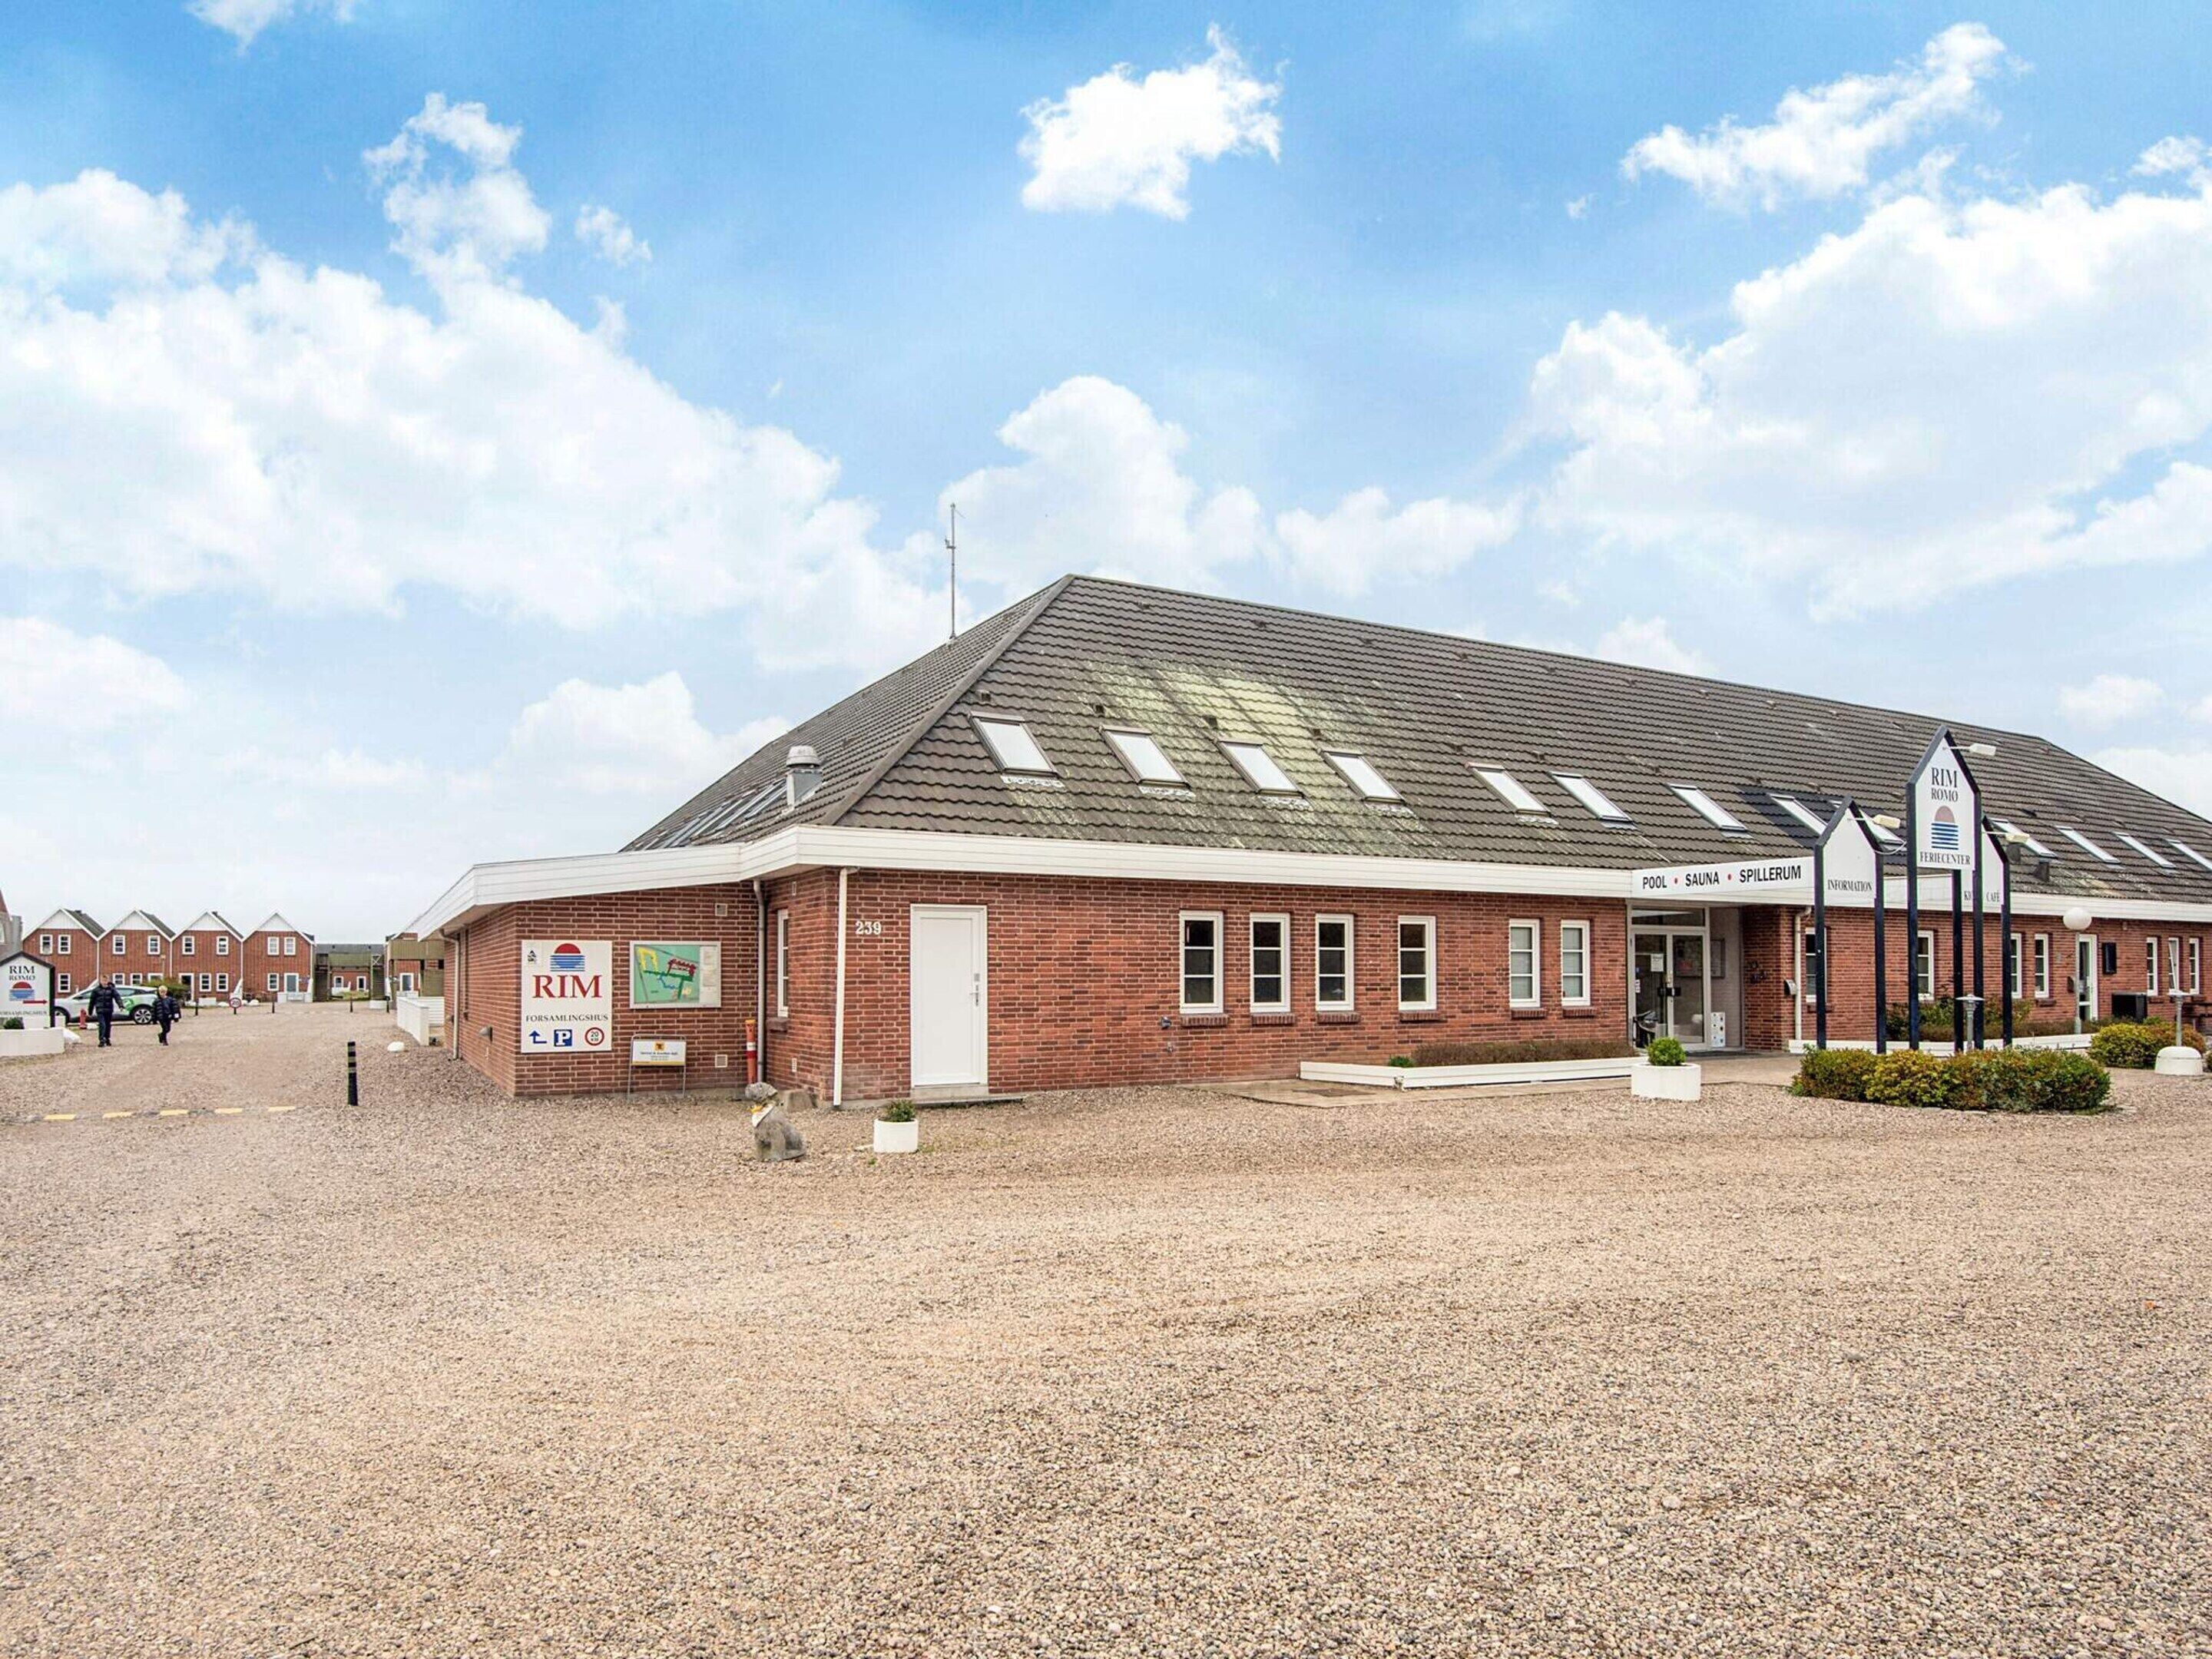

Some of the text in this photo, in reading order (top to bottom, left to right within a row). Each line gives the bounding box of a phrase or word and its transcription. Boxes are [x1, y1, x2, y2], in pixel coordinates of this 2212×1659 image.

[1931, 767, 1958, 788] RIM
[1919, 851, 1971, 866] FERIECENTER
[1642, 865, 1802, 889] POOL SAUNA SPILLERUM
[1827, 879, 1873, 892] INFORMATION
[855, 920, 882, 935] 239
[9, 965, 35, 974] RIM
[531, 975, 603, 998] RIM
[525, 1013, 609, 1023] FORSAMLINGSHUS
[555, 1031, 571, 1046] P
